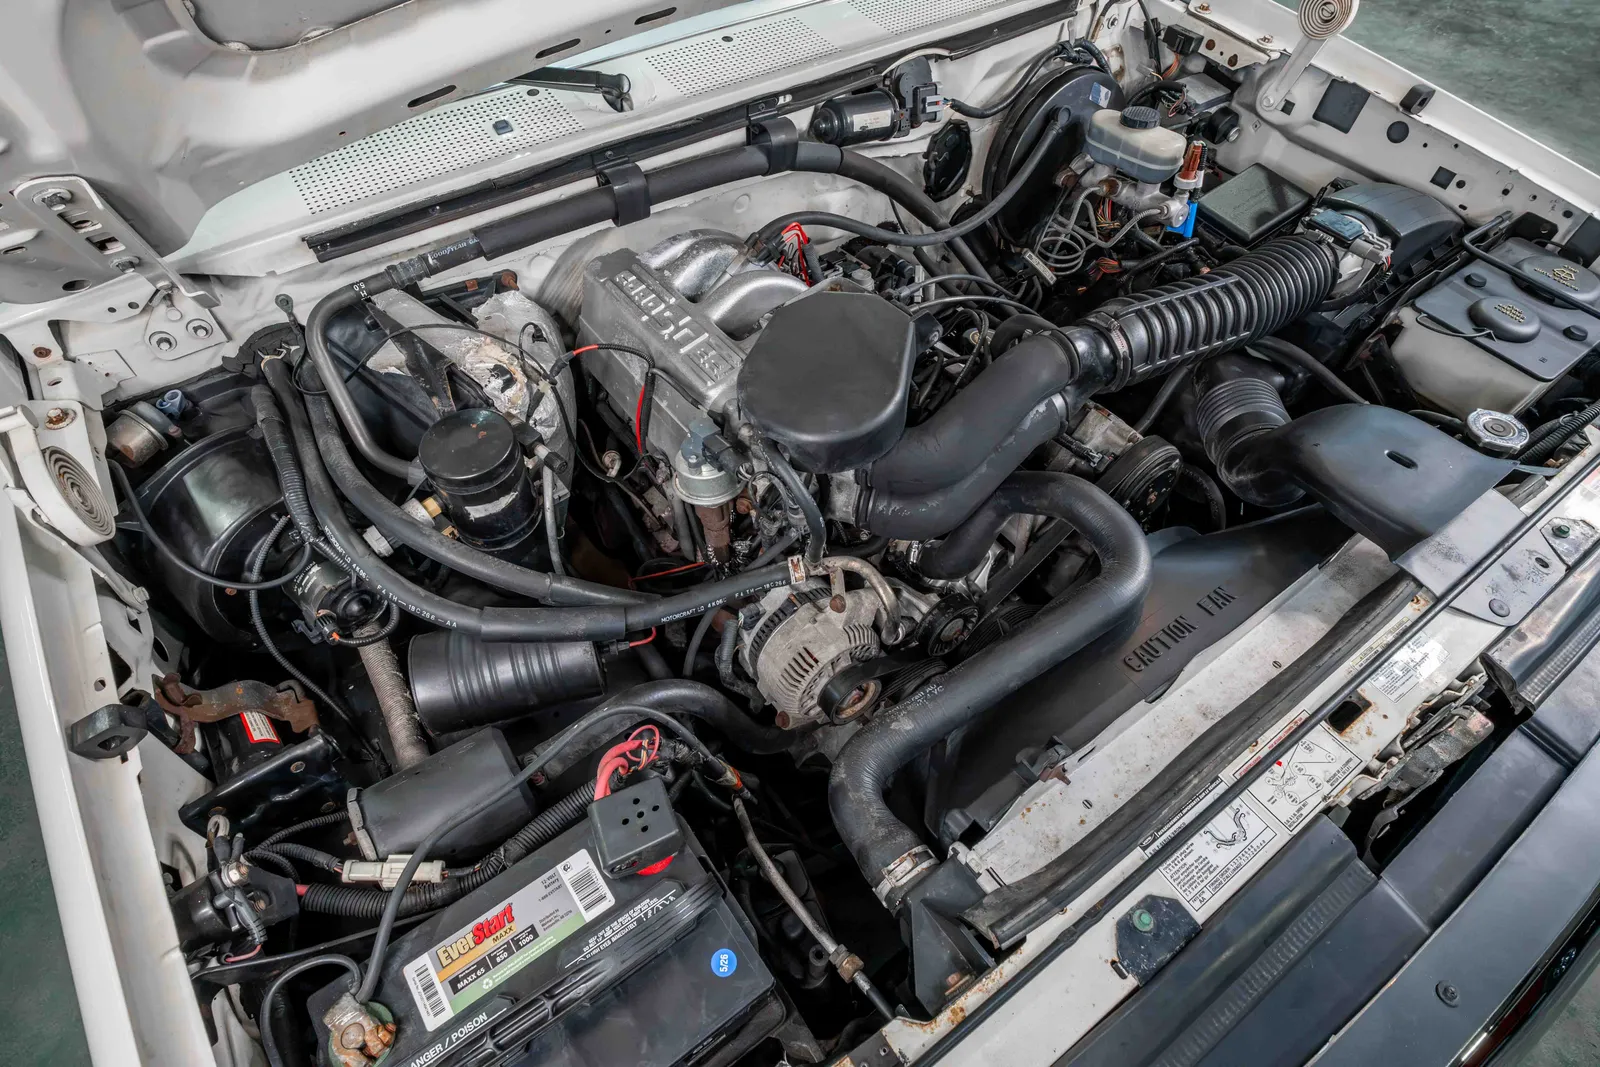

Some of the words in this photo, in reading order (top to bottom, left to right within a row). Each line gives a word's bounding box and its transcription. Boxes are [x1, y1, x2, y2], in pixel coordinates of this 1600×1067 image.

[661, 609, 696, 623] MOTORCRAFT
[1123, 615, 1199, 673] CAUTION
[1196, 586, 1238, 617] FAN
[436, 903, 515, 968] EverStart
[492, 925, 514, 944] MAXX
[519, 934, 534, 947] 1000
[600, 940, 612, 950] EYES
[611, 921, 638, 943] IMMEDIATELY
[496, 951, 508, 963] 850
[719, 953, 729, 973] 5/26
[457, 972, 476, 990] MAXX
[476, 967, 485, 977] 65
[404, 1043, 444, 1067] ANGER
[451, 1012, 488, 1042] POISON
